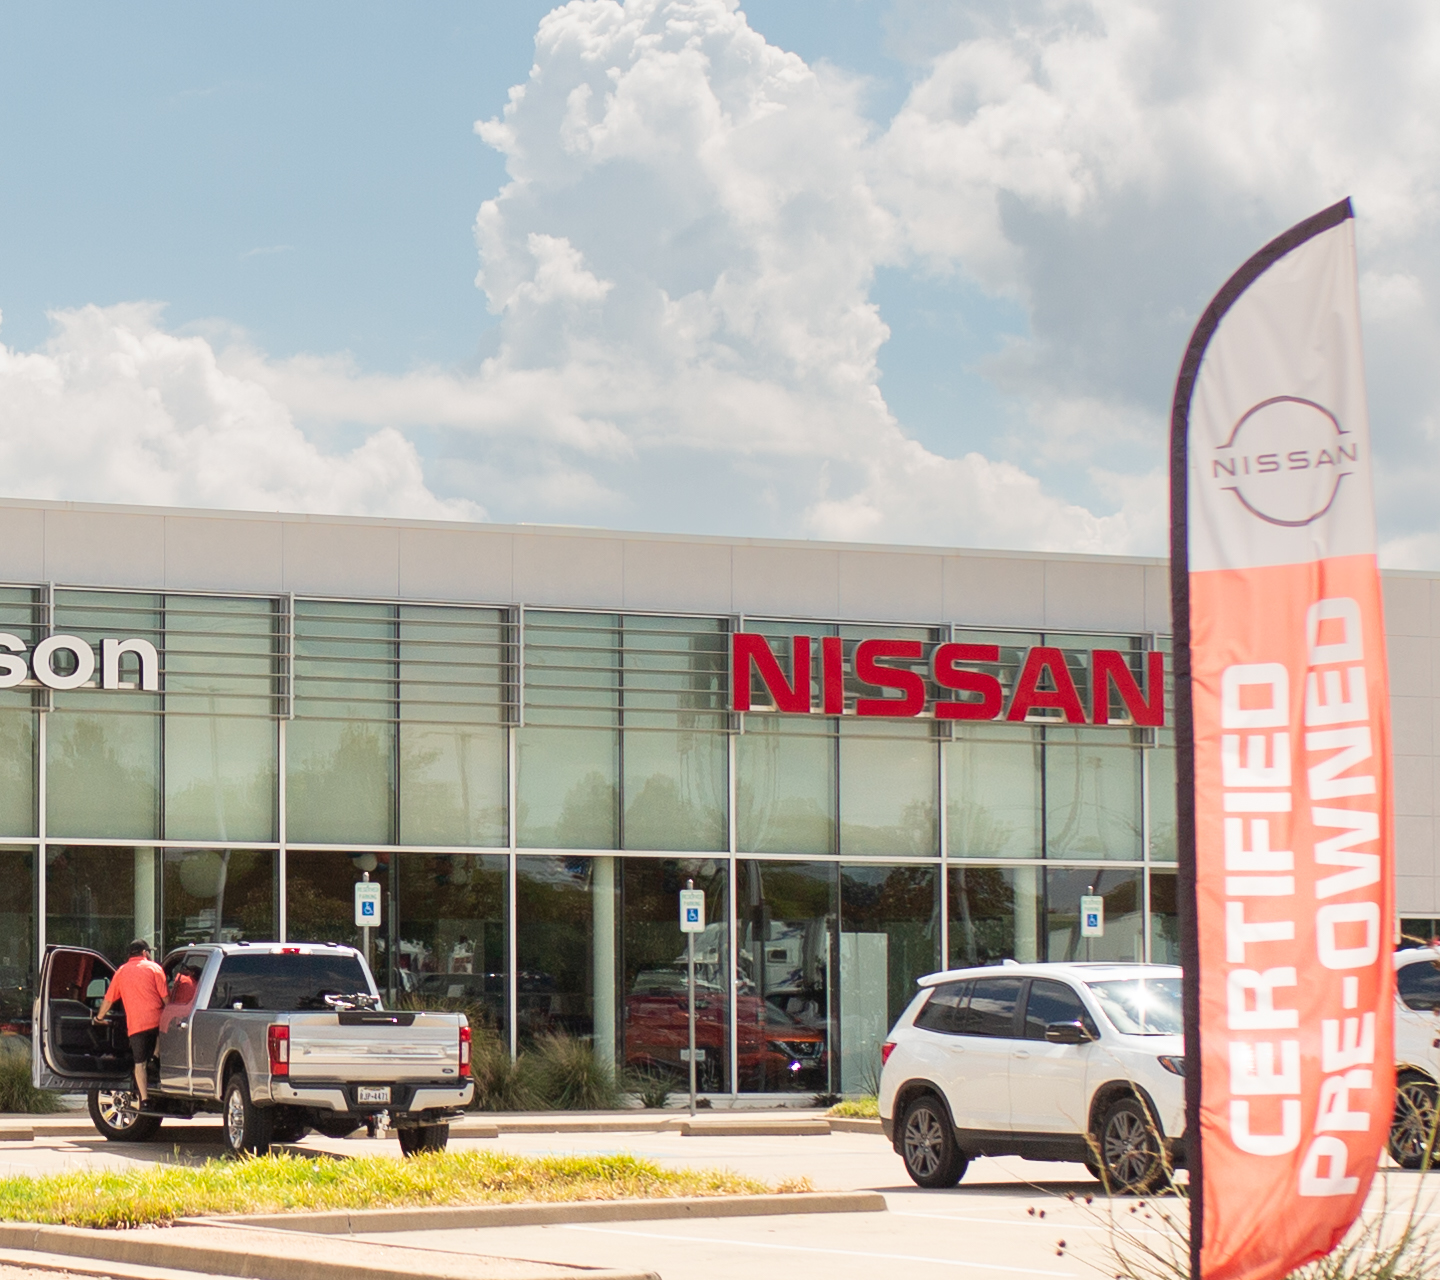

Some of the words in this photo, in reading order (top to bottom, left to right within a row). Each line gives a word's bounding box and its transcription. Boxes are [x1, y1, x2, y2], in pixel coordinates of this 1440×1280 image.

[1213, 443, 1357, 478] NISSAN
[732, 632, 1164, 727] NISSAN
[1221, 662, 1301, 1157] CERTIFIED
[1298, 596, 1380, 1197] PRE-OWNED
